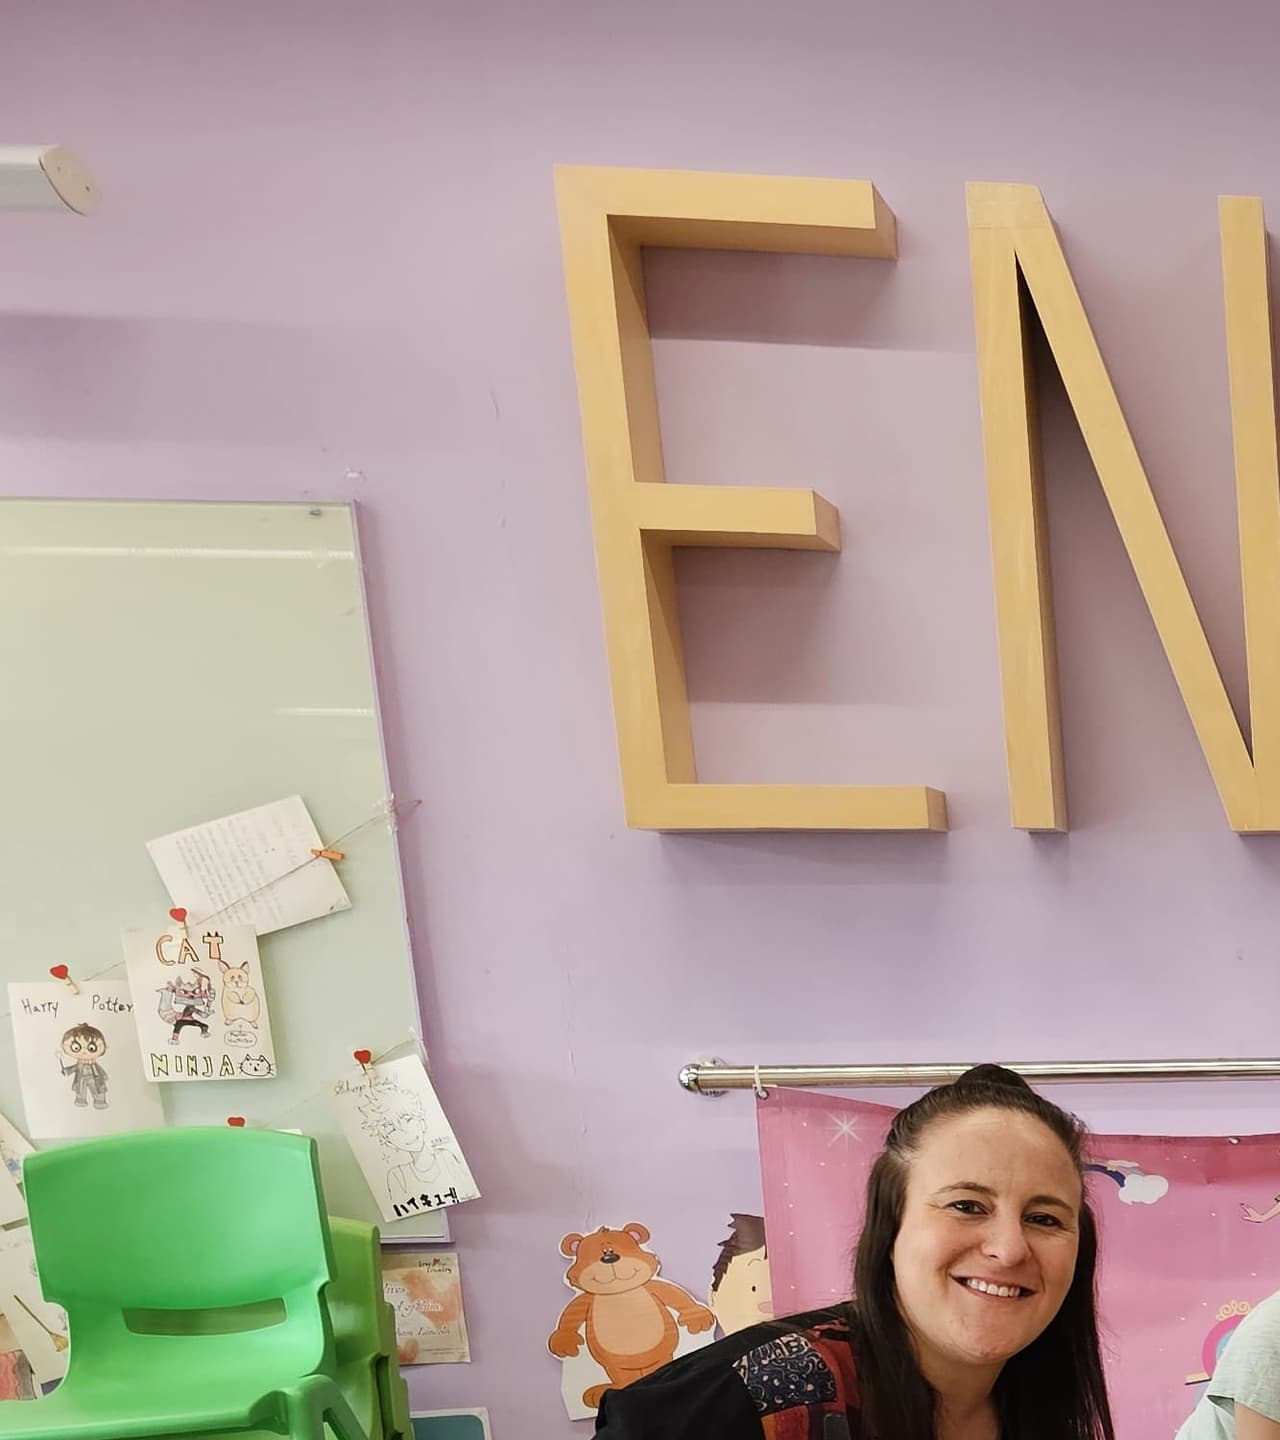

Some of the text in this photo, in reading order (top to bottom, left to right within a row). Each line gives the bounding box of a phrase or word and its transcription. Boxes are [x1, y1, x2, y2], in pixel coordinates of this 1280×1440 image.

[155, 931, 224, 966] CAT
[21, 993, 134, 1019] Harry Potter
[150, 1052, 235, 1078] NINJA
